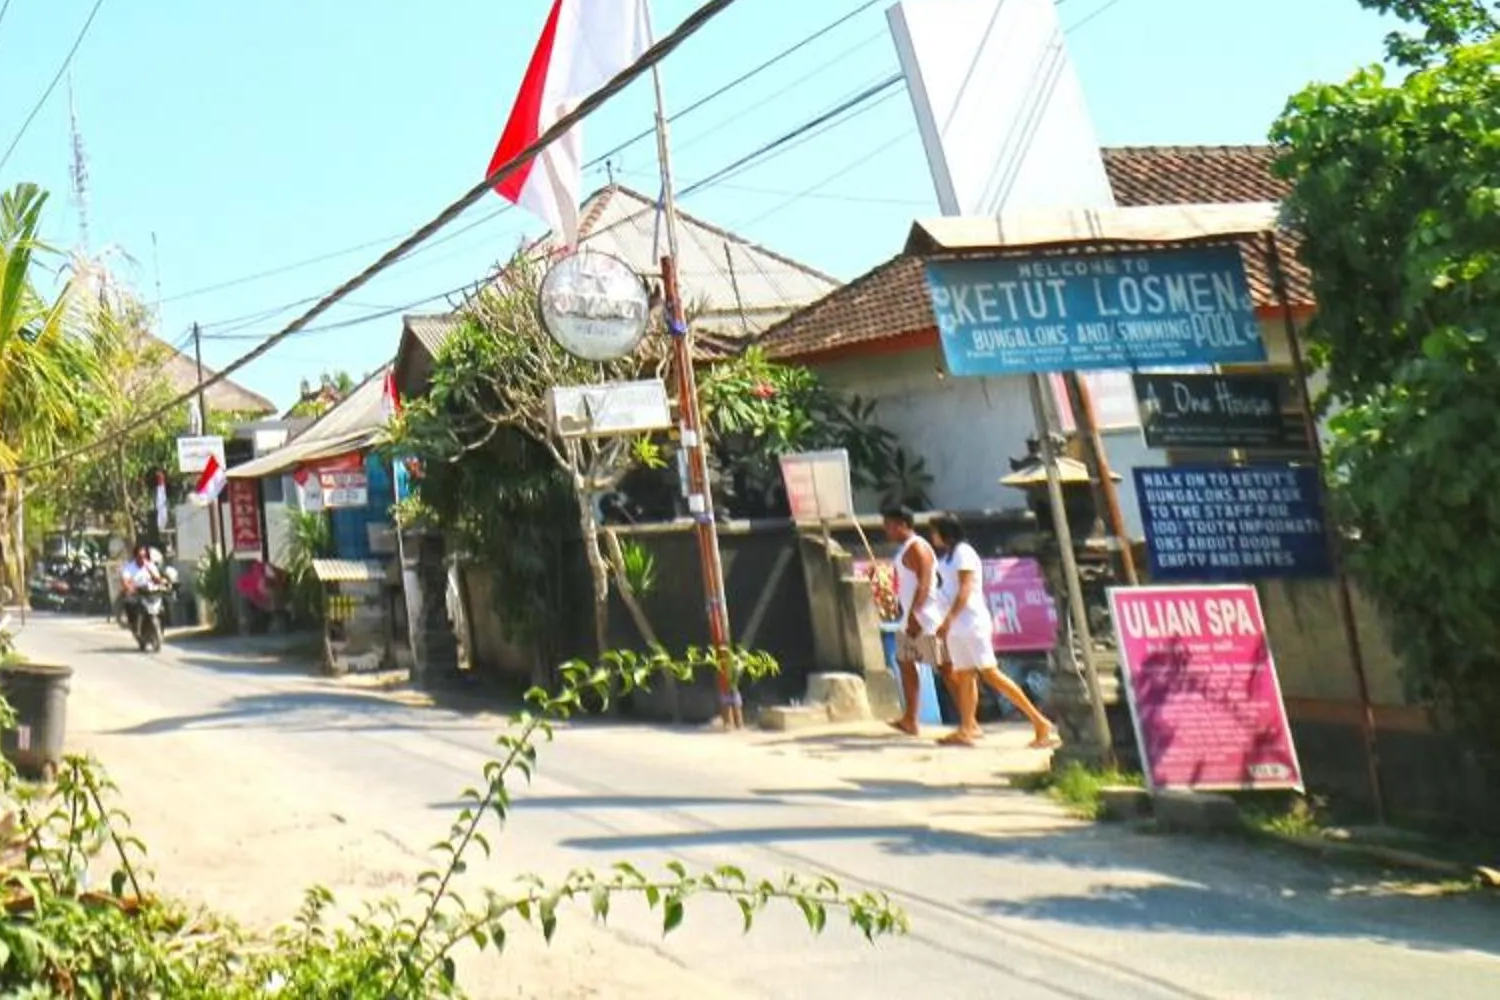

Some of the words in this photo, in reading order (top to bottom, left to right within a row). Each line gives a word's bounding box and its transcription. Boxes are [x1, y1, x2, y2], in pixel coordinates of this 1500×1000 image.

[1121, 258, 1151, 274] TO
[950, 278, 1068, 325] KETUT
[1092, 270, 1240, 317] LOSMEN
[972, 325, 1069, 351] BUNGALOWS
[1190, 309, 1247, 349] POOL
[1208, 471, 1229, 486] TO
[1238, 488, 1270, 502] AND
[1149, 505, 1169, 518] TO
[1172, 504, 1201, 518] THE
[1203, 503, 1254, 518] STAFF
[1121, 599, 1203, 639] ULIAN
[1203, 597, 1259, 637] SPA
